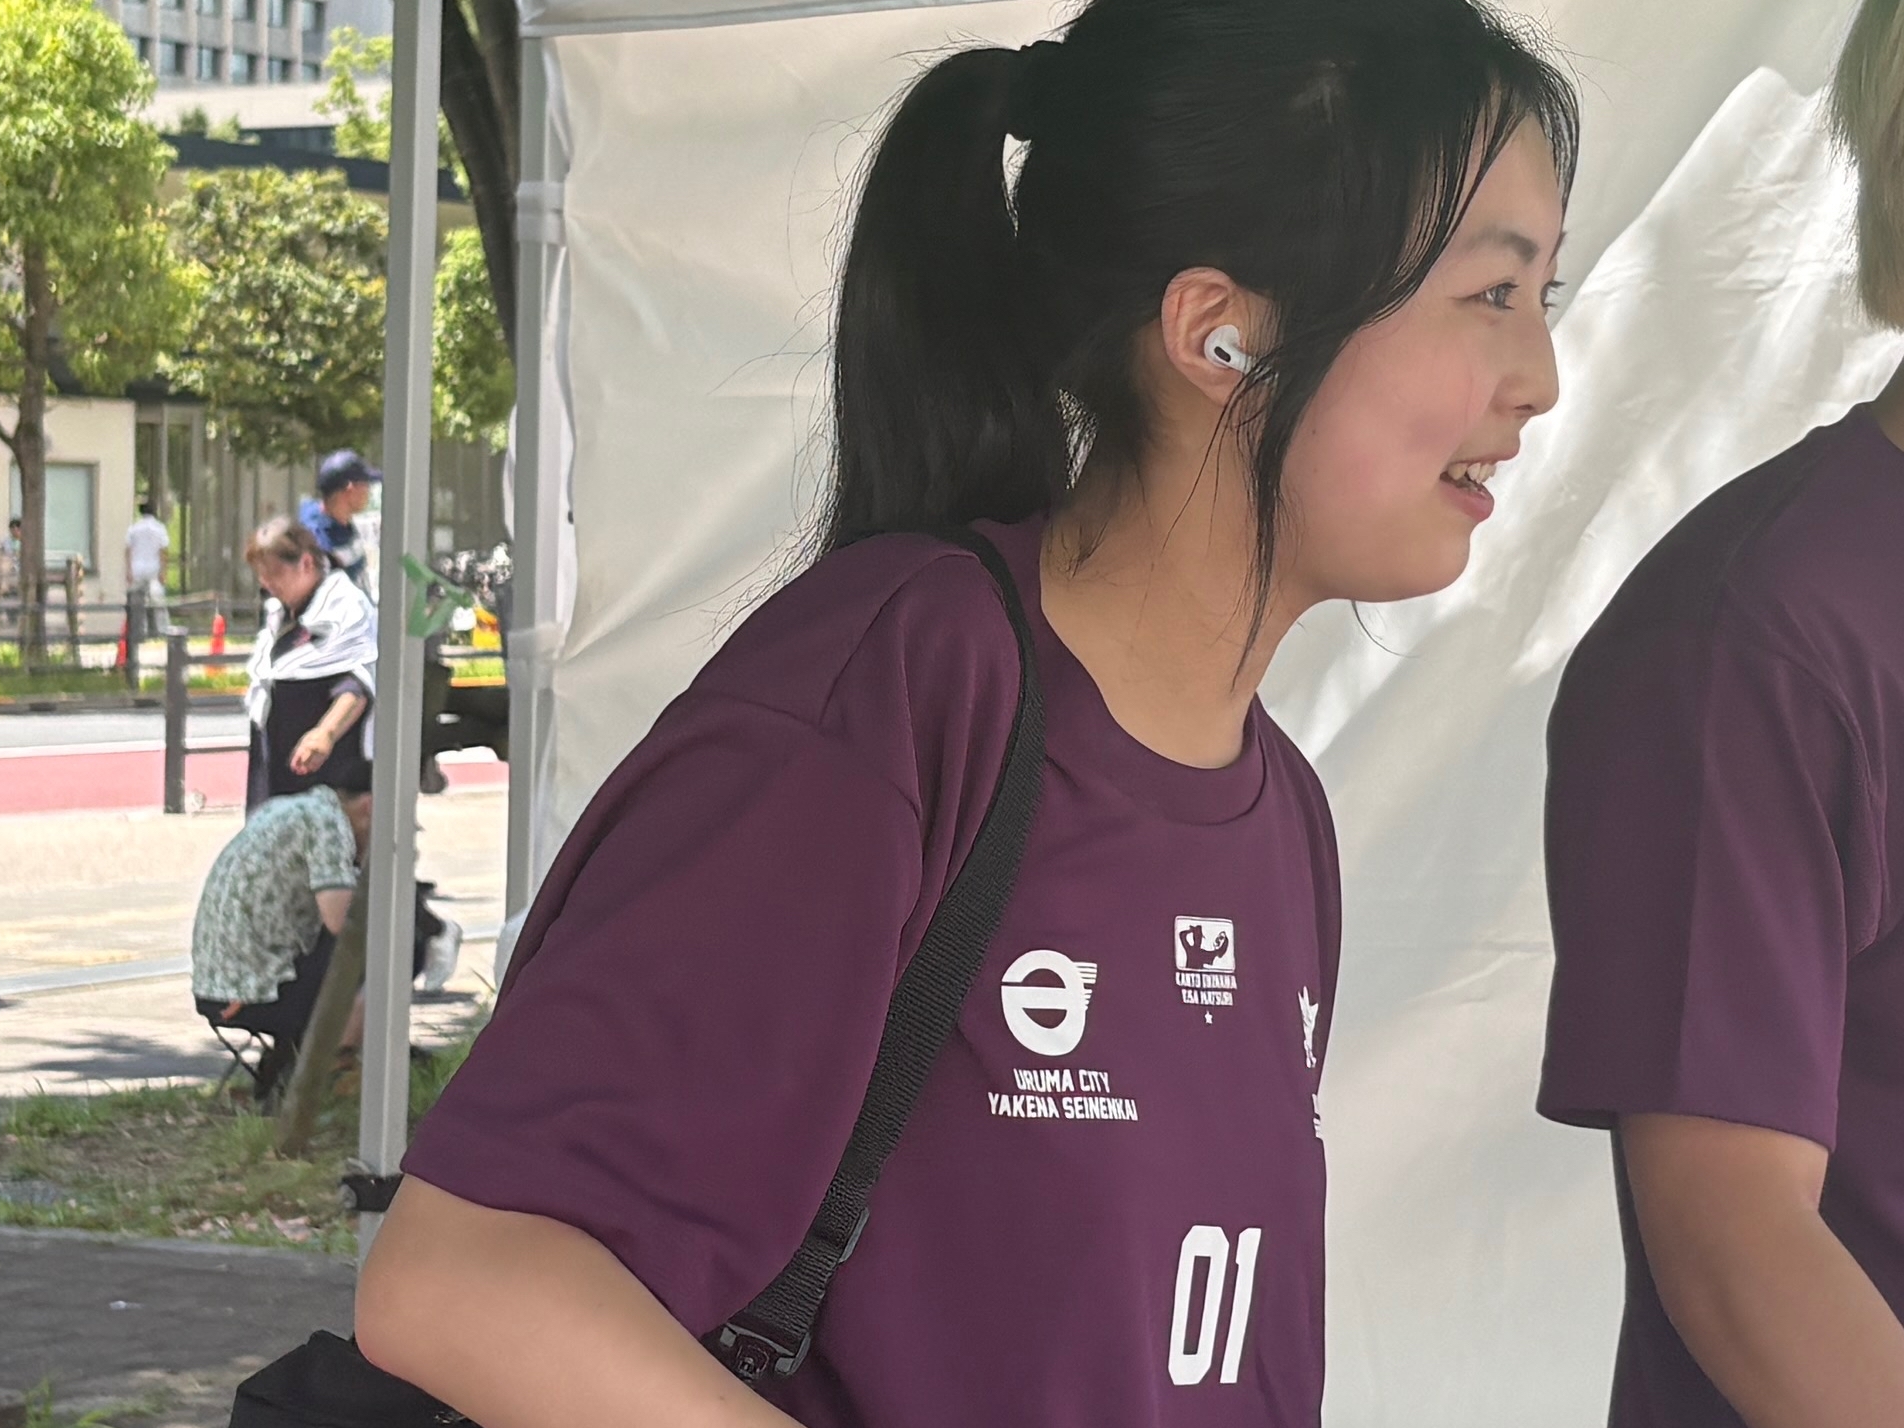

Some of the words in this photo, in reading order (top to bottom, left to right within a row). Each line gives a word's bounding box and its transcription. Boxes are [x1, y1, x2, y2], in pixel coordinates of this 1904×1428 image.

[1013, 1068, 1075, 1093] URUMA
[1079, 1069, 1110, 1093] CITY
[988, 1092, 1060, 1119] YAKENA
[1062, 1096, 1139, 1121] SEINENKAI
[1168, 1224, 1262, 1385] 01
